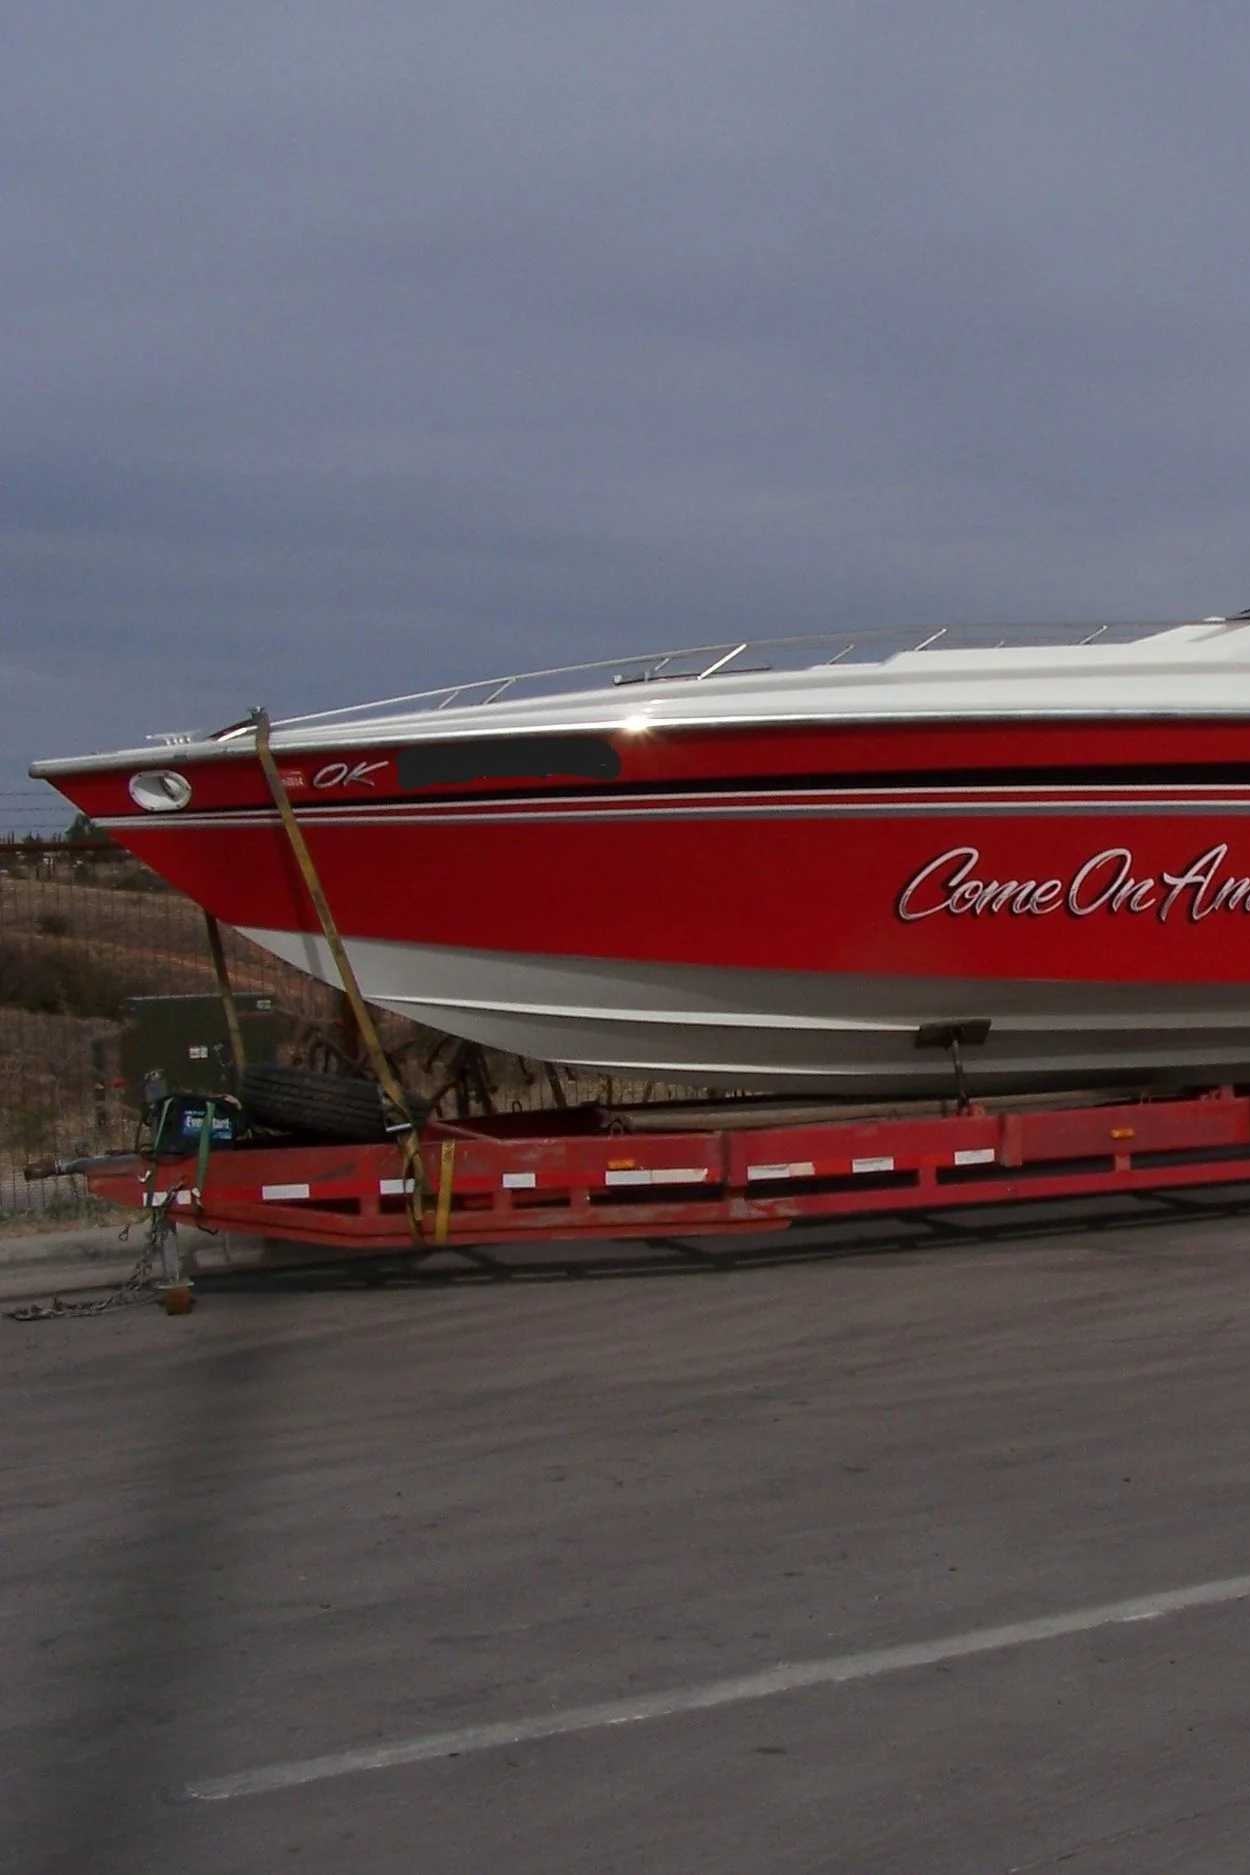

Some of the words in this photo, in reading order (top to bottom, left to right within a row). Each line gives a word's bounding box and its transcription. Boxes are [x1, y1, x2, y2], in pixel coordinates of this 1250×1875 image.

[313, 760, 390, 789] OK
[898, 846, 1064, 921] Come
[1068, 847, 1157, 917] On
